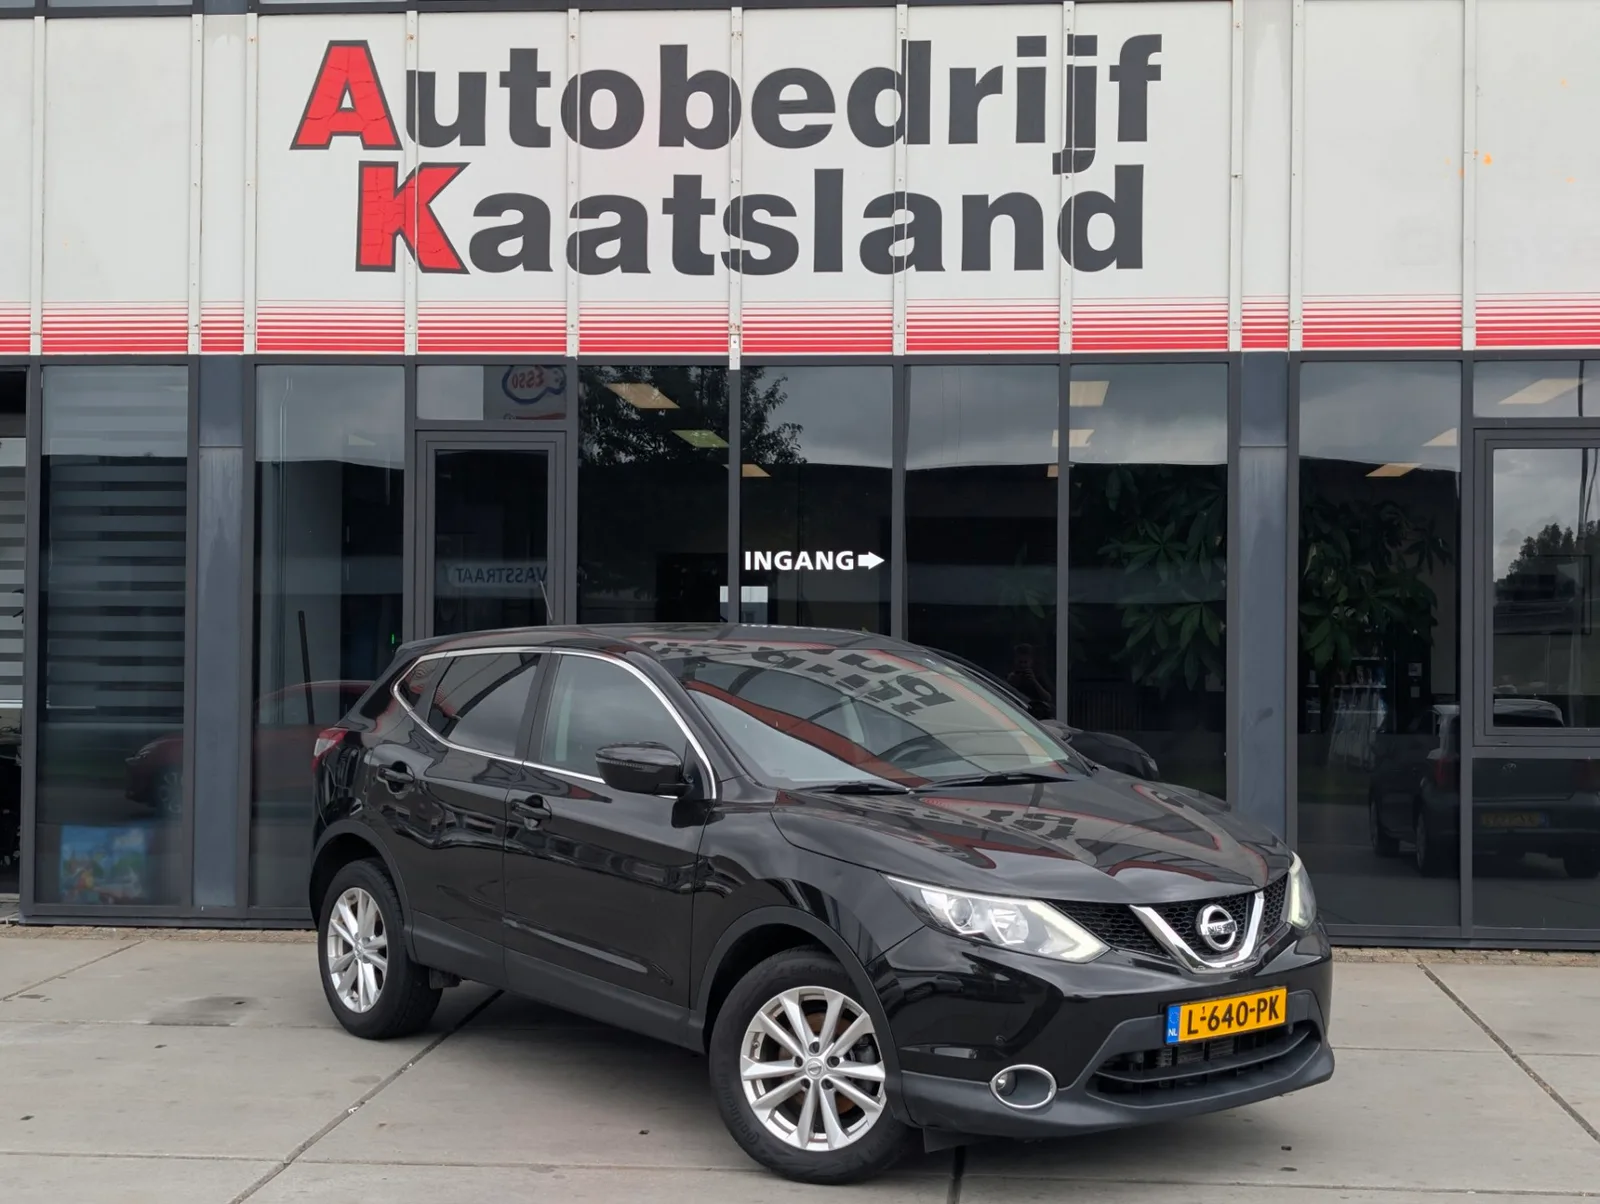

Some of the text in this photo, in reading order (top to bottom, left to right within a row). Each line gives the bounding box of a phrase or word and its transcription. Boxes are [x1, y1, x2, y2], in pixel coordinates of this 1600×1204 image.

[289, 34, 1162, 175] Autobedrijf
[355, 160, 1144, 276] Kaatsland
[744, 551, 854, 571] INGANG
[1168, 1028, 1178, 1037] NL
